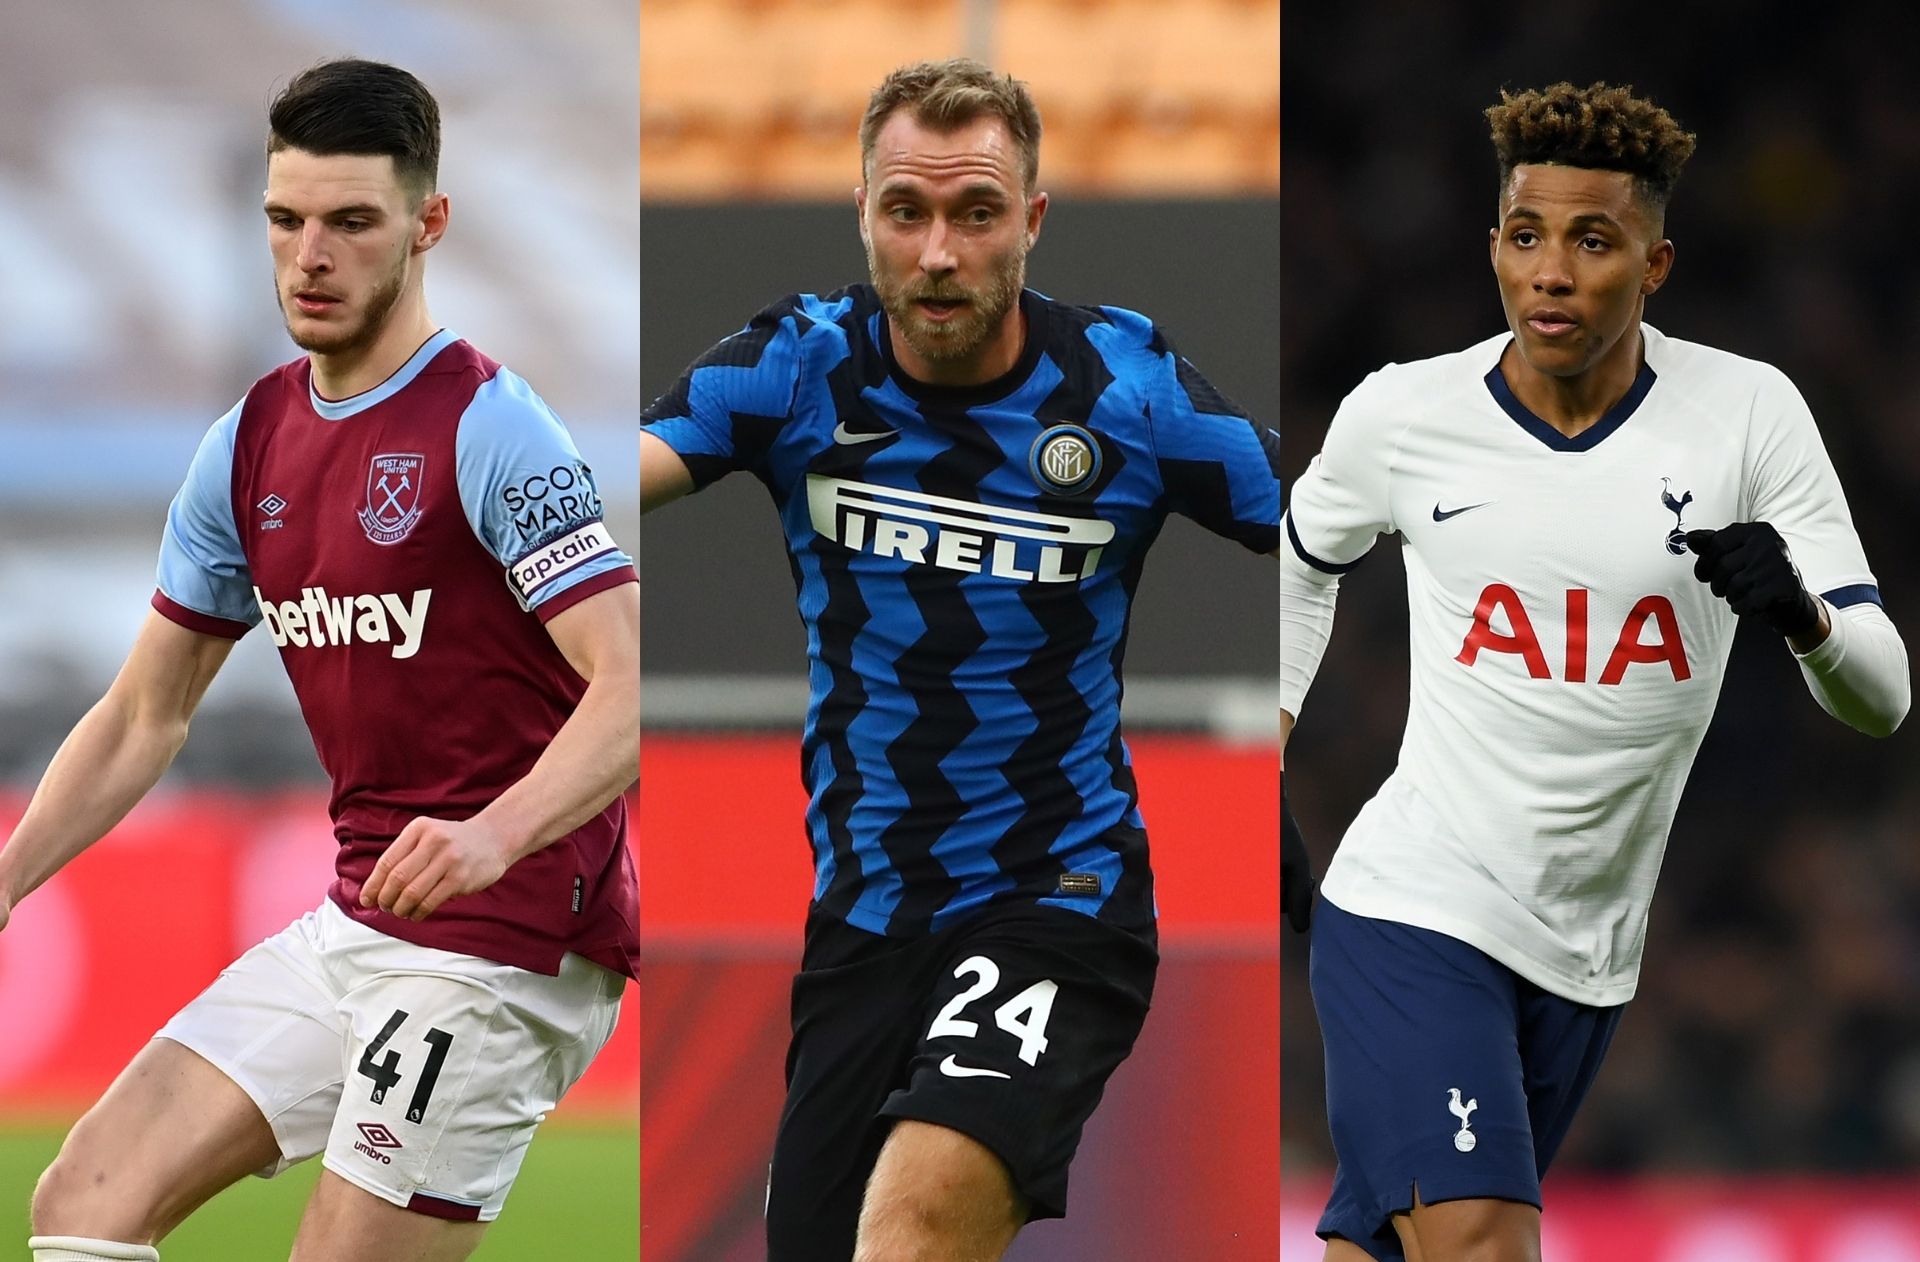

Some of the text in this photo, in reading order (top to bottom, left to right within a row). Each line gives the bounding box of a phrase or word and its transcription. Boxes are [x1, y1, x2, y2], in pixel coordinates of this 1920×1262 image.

[377, 459, 416, 468] WEST HAM
[260, 518, 284, 530] umbro
[384, 530, 402, 540] YEARS
[806, 472, 1116, 583] PIRELLI
[252, 585, 433, 659] betway
[1453, 583, 1692, 685] AIA
[926, 955, 1059, 1067] 24
[357, 1009, 454, 1125] 41
[353, 1140, 391, 1165] umbro
